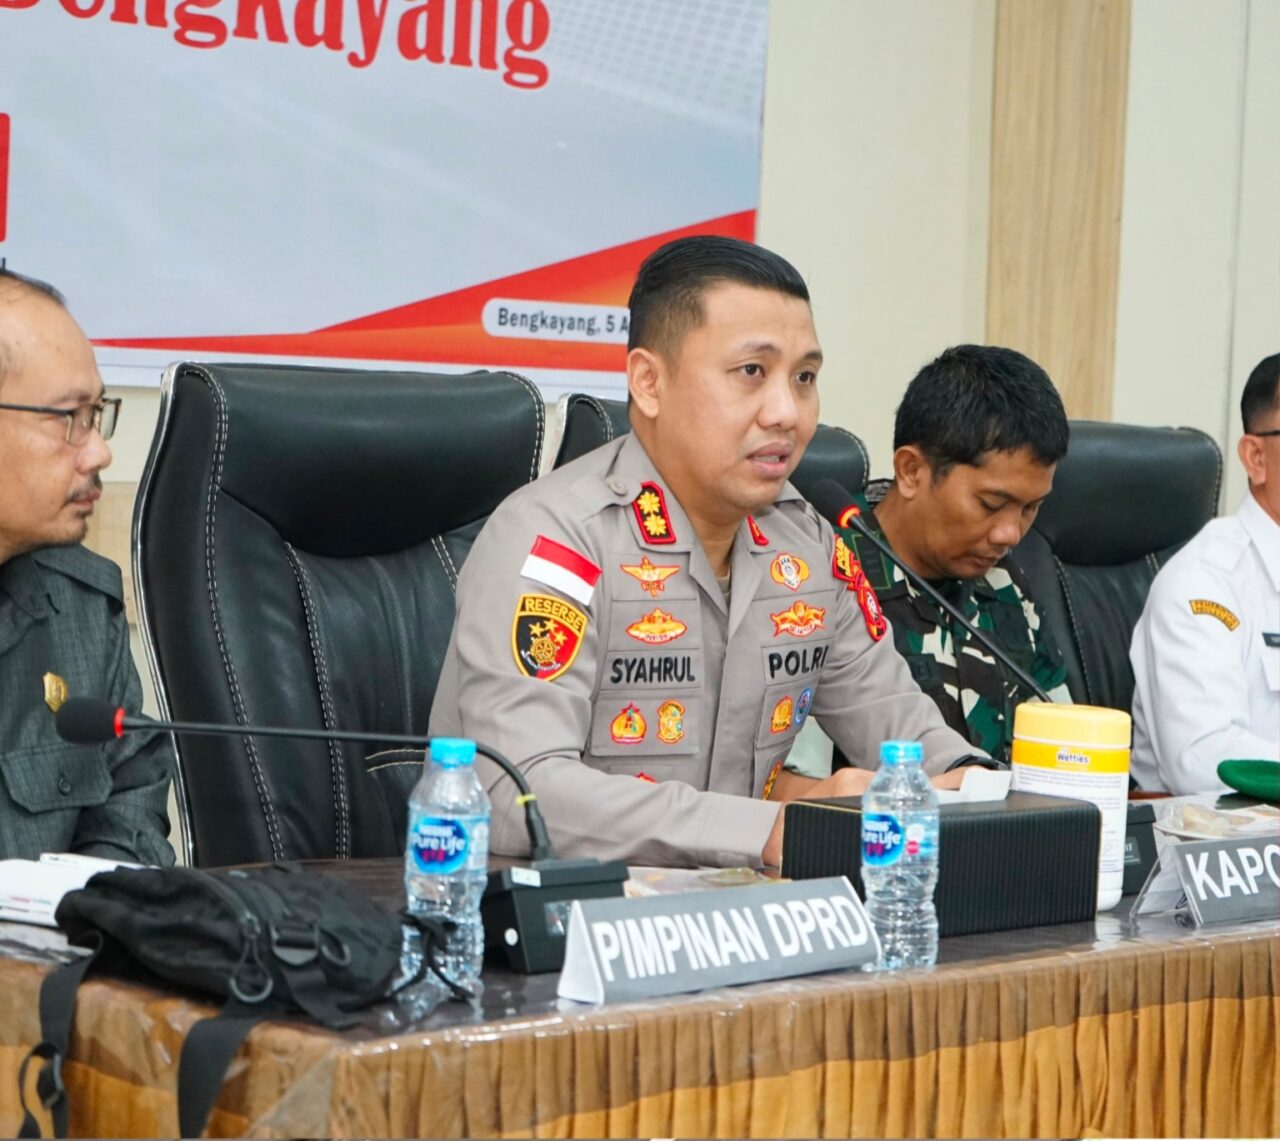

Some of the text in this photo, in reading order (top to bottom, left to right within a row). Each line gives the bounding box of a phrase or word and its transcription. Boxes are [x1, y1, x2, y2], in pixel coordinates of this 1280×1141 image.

[605, 314, 616, 333] 5
[525, 598, 585, 630] RESERSE
[610, 656, 696, 684] SYAHRUL
[768, 645, 829, 679] POLRI
[592, 896, 869, 982] PIMPINAN DPRD
